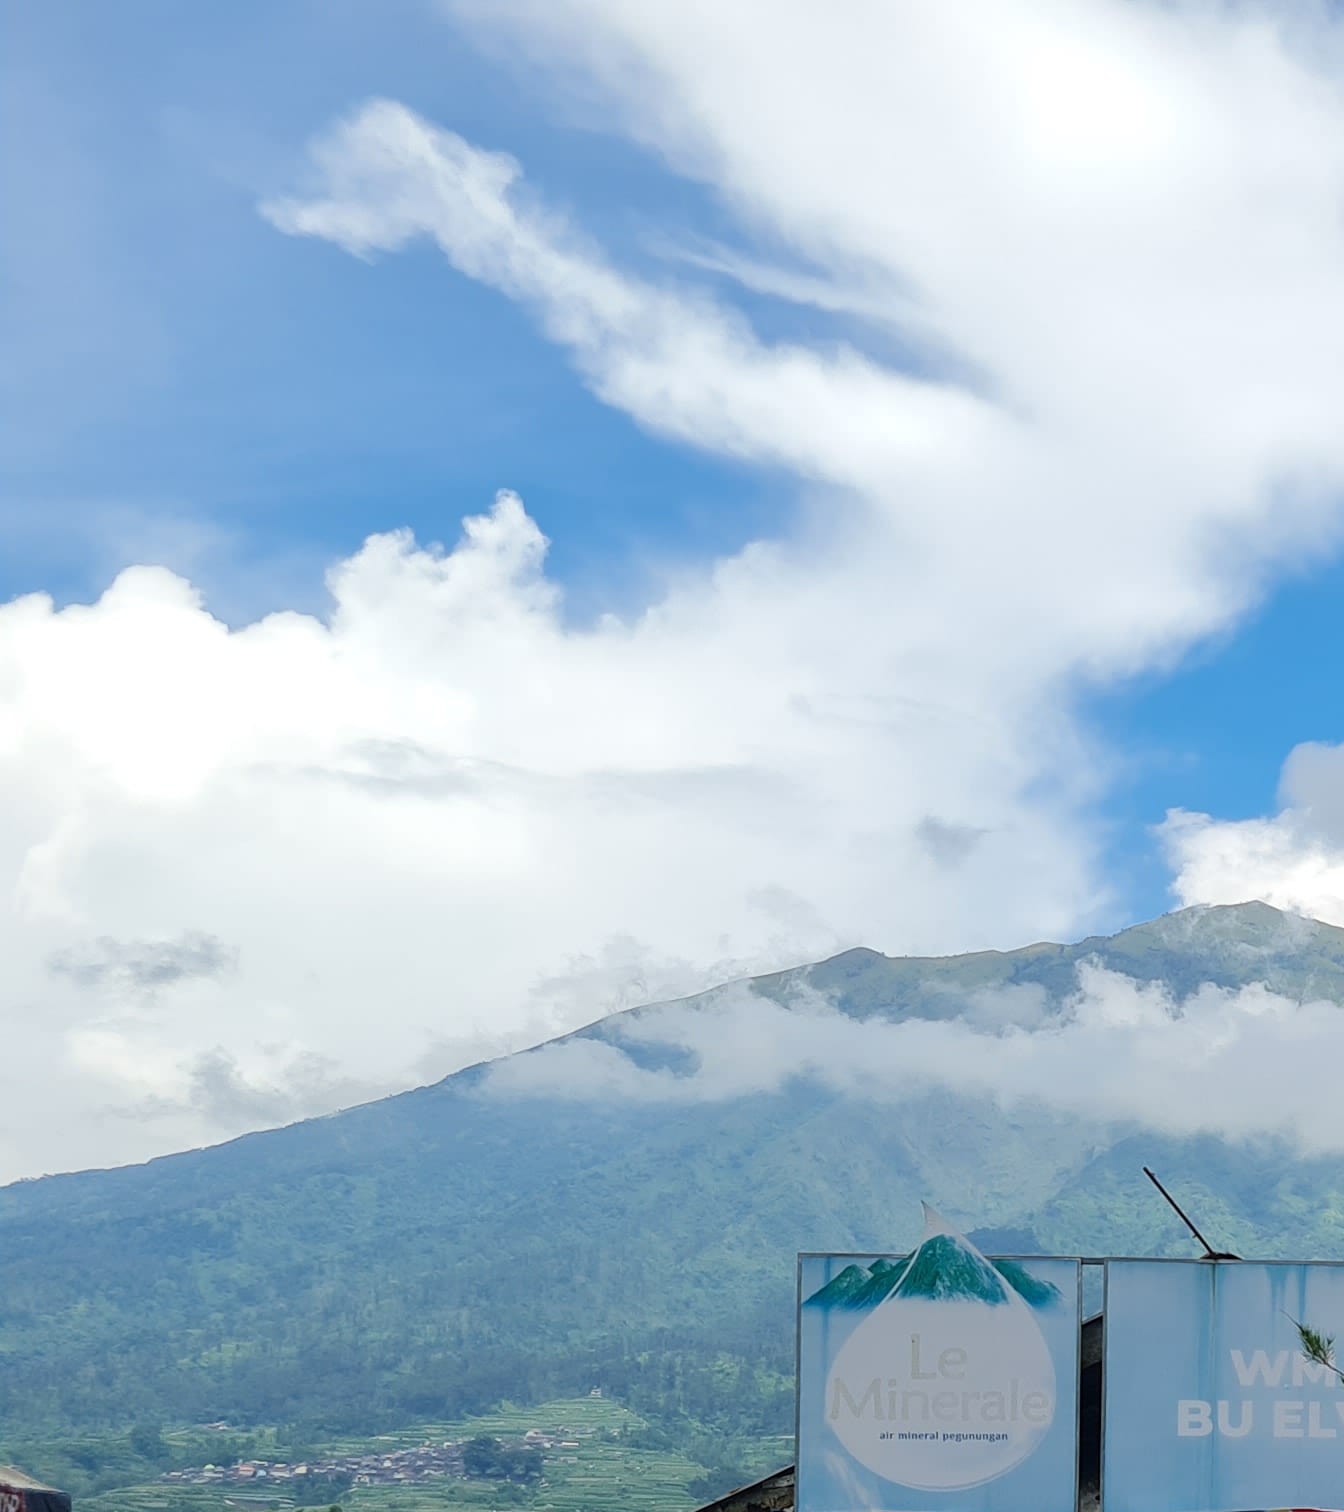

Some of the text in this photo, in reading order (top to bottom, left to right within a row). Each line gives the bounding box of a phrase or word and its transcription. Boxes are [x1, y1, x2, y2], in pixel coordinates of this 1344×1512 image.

[910, 1333, 968, 1381] Le
[1229, 1348, 1338, 1388] WM
[829, 1377, 1050, 1422] Minerale
[1177, 1399, 1254, 1438] BU
[879, 1431, 1009, 1443] air mineral pegunungan
